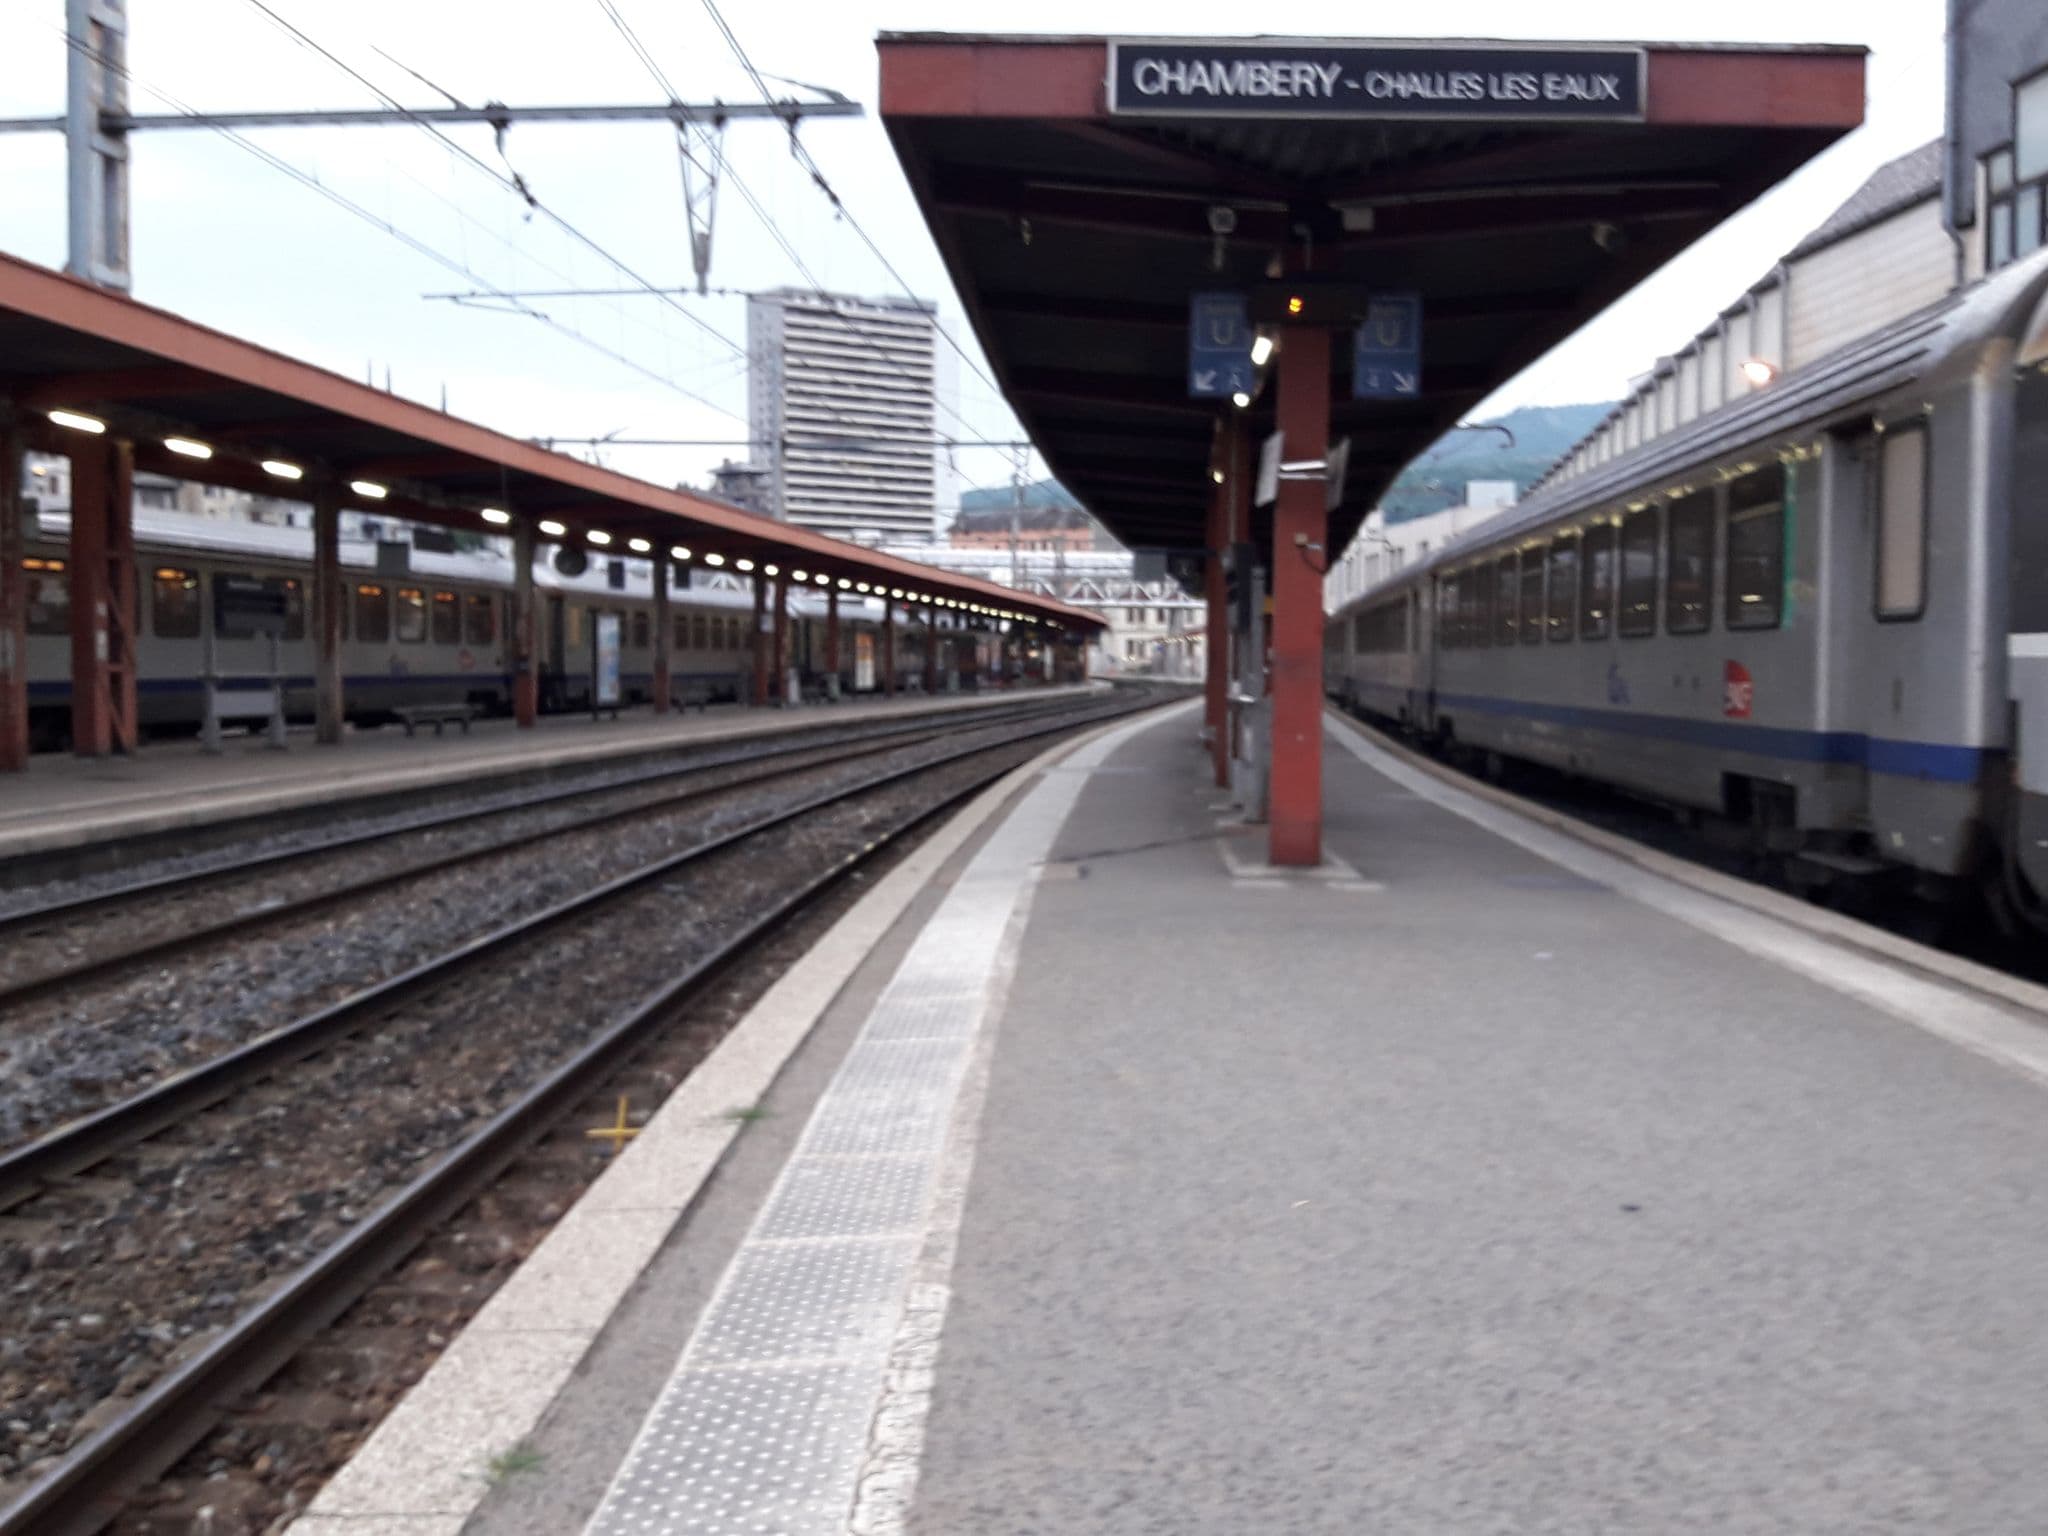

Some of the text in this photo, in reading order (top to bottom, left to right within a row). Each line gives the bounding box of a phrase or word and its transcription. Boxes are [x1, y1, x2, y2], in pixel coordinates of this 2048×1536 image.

[1132, 57, 1342, 98] CHAMBERY
[1364, 70, 1485, 100] CHALLES
[1488, 72, 1540, 101] LES
[1541, 73, 1621, 101] EAUX
